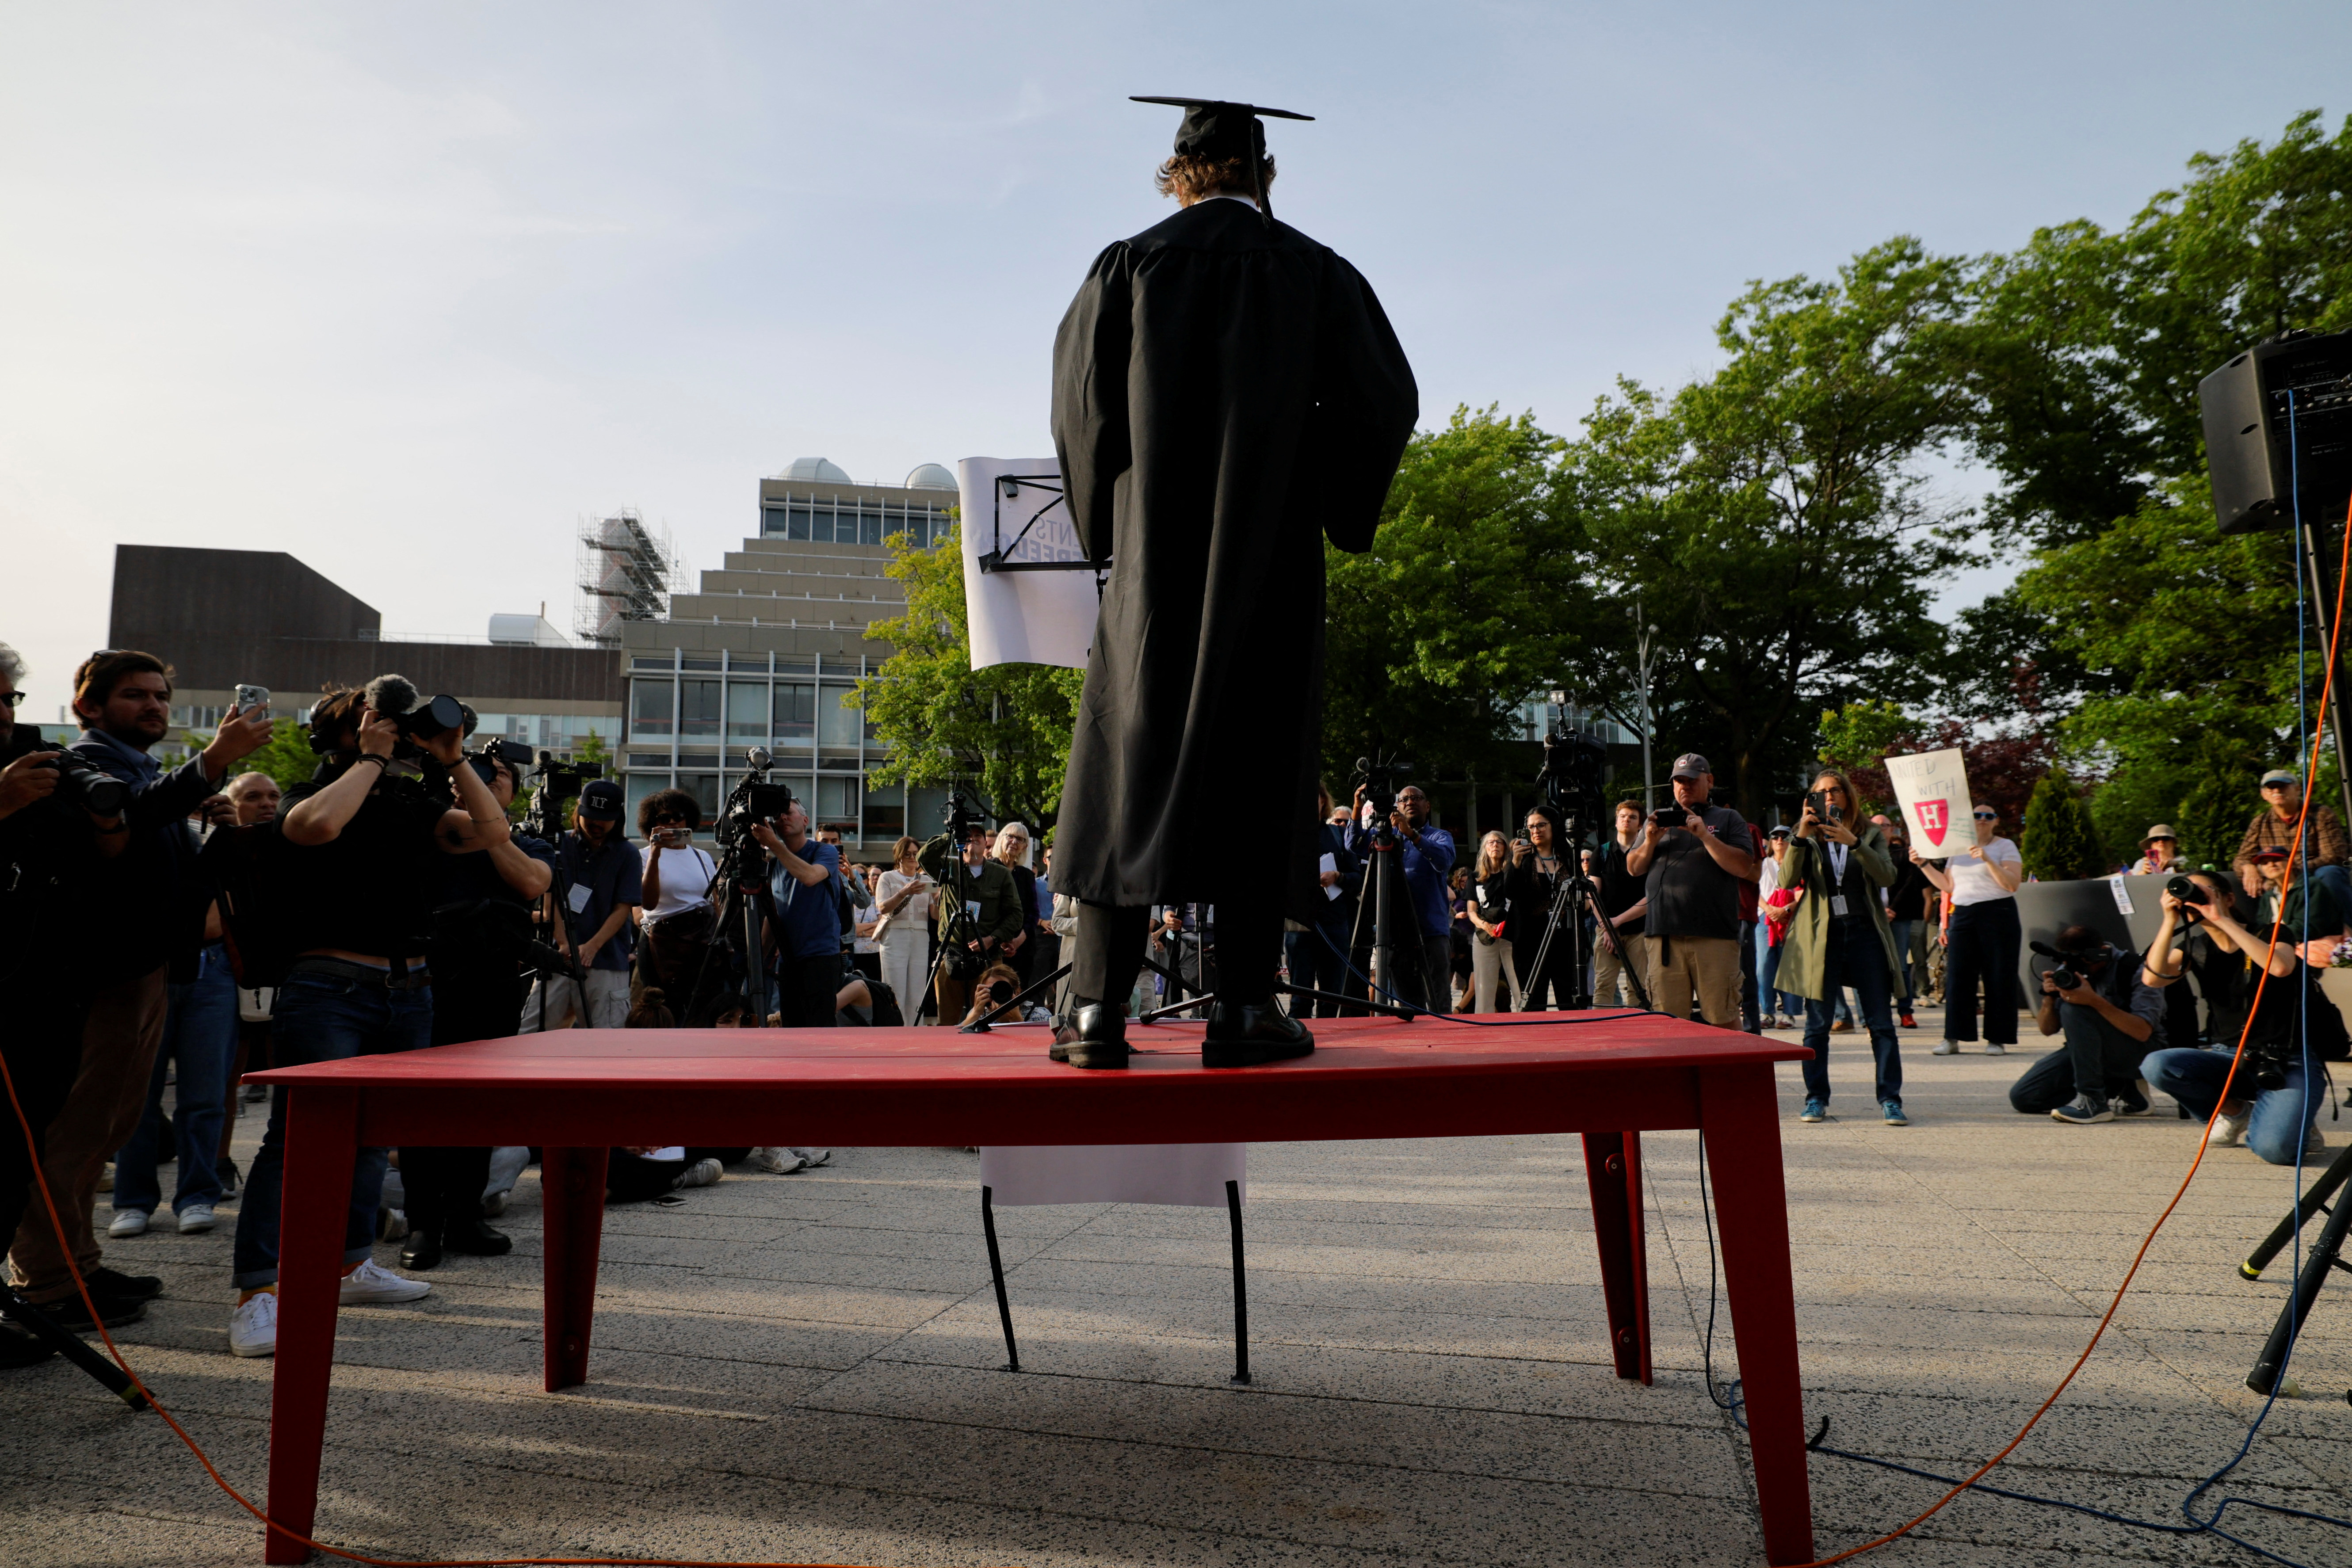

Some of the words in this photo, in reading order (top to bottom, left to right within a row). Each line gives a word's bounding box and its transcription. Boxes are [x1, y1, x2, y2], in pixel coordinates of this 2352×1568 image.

[1893, 759, 1936, 778] UNITED
[1917, 777, 1955, 796] WITH
[591, 796, 608, 809] NY
[1921, 804, 1942, 829] H
